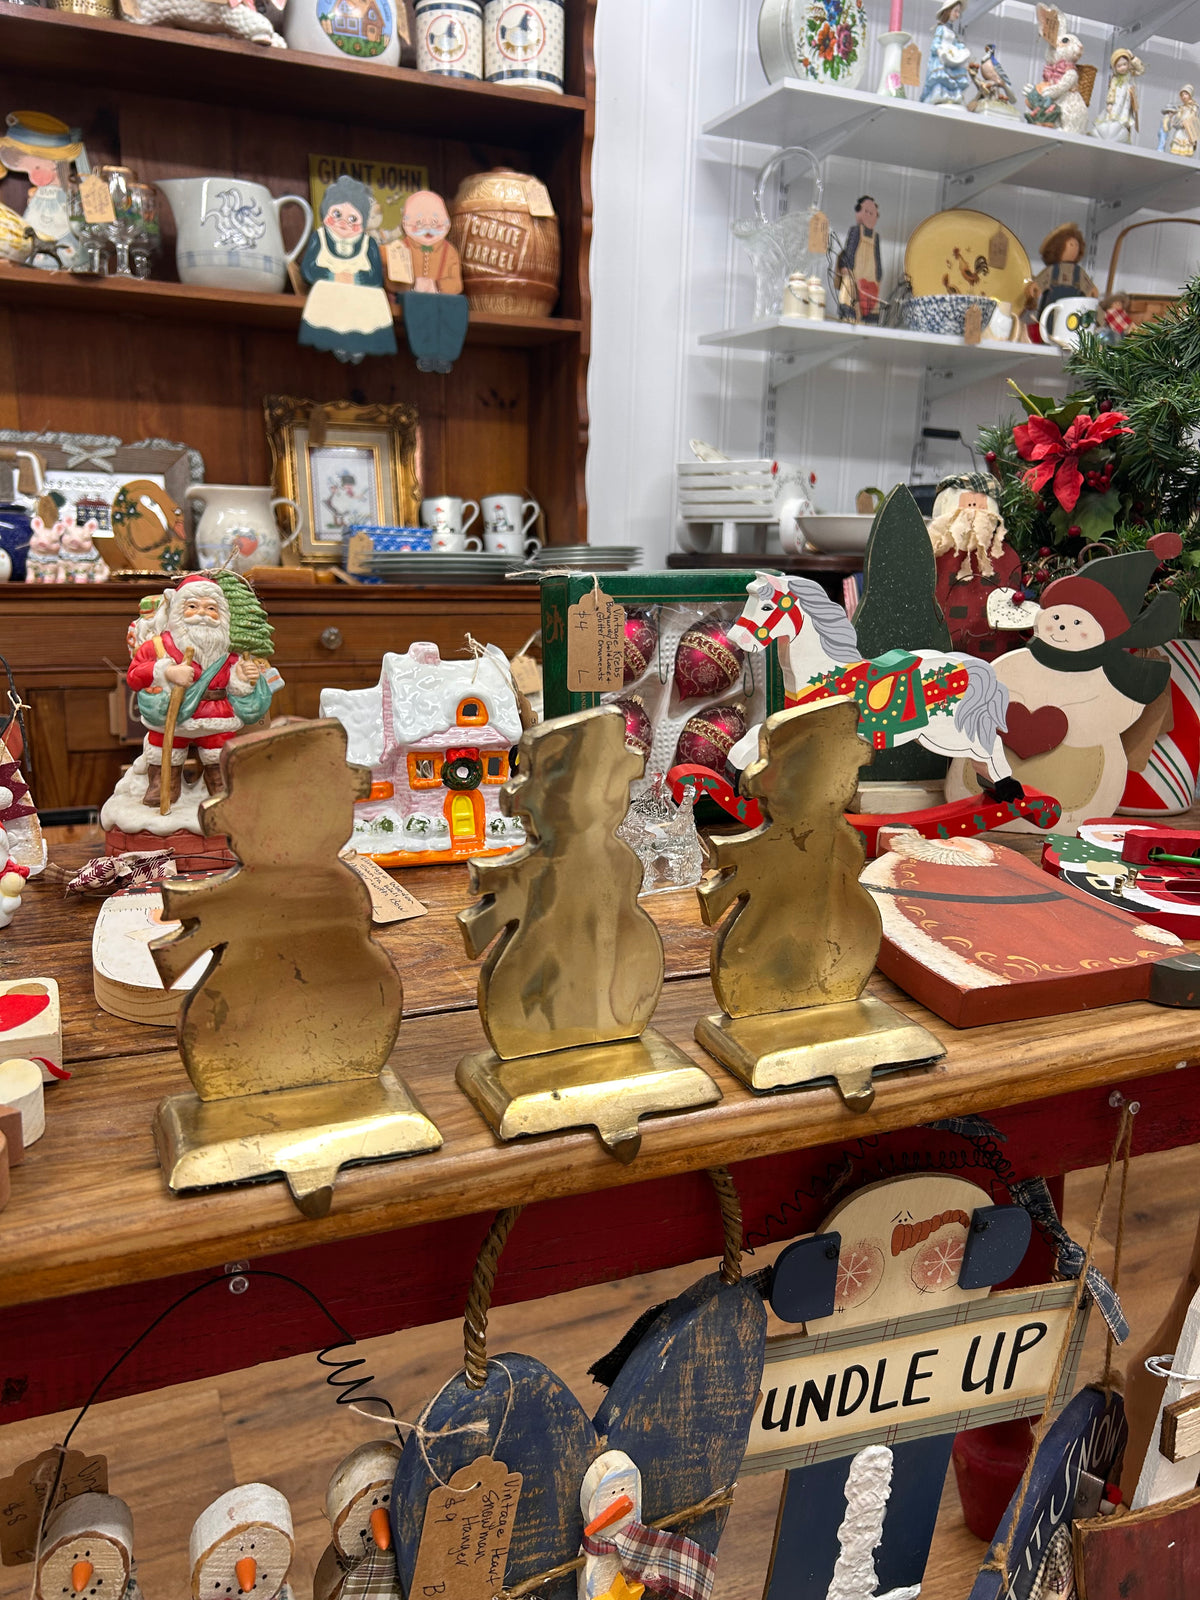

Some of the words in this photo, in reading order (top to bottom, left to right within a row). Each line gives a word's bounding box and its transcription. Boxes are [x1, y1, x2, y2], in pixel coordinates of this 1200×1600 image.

[317, 158, 374, 186] GIANT
[378, 167, 422, 192] JOHN
[469, 216, 522, 246] COOKIE
[465, 242, 515, 271] BARREL
[596, 612, 605, 638] Glitter
[612, 608, 623, 647] Vintage
[596, 639, 605, 681] Ornaments
[612, 651, 623, 678] Krebs
[761, 1349, 939, 1433] UNDLE
[961, 1321, 1048, 1396] UP
[1024, 1509, 1045, 1572] IT
[1049, 1405, 1126, 1526] SNOW
[490, 1479, 520, 1539] Vintage
[447, 1514, 480, 1567] Hanger
[486, 1547, 508, 1587] Heart
[422, 1580, 446, 1598] B
